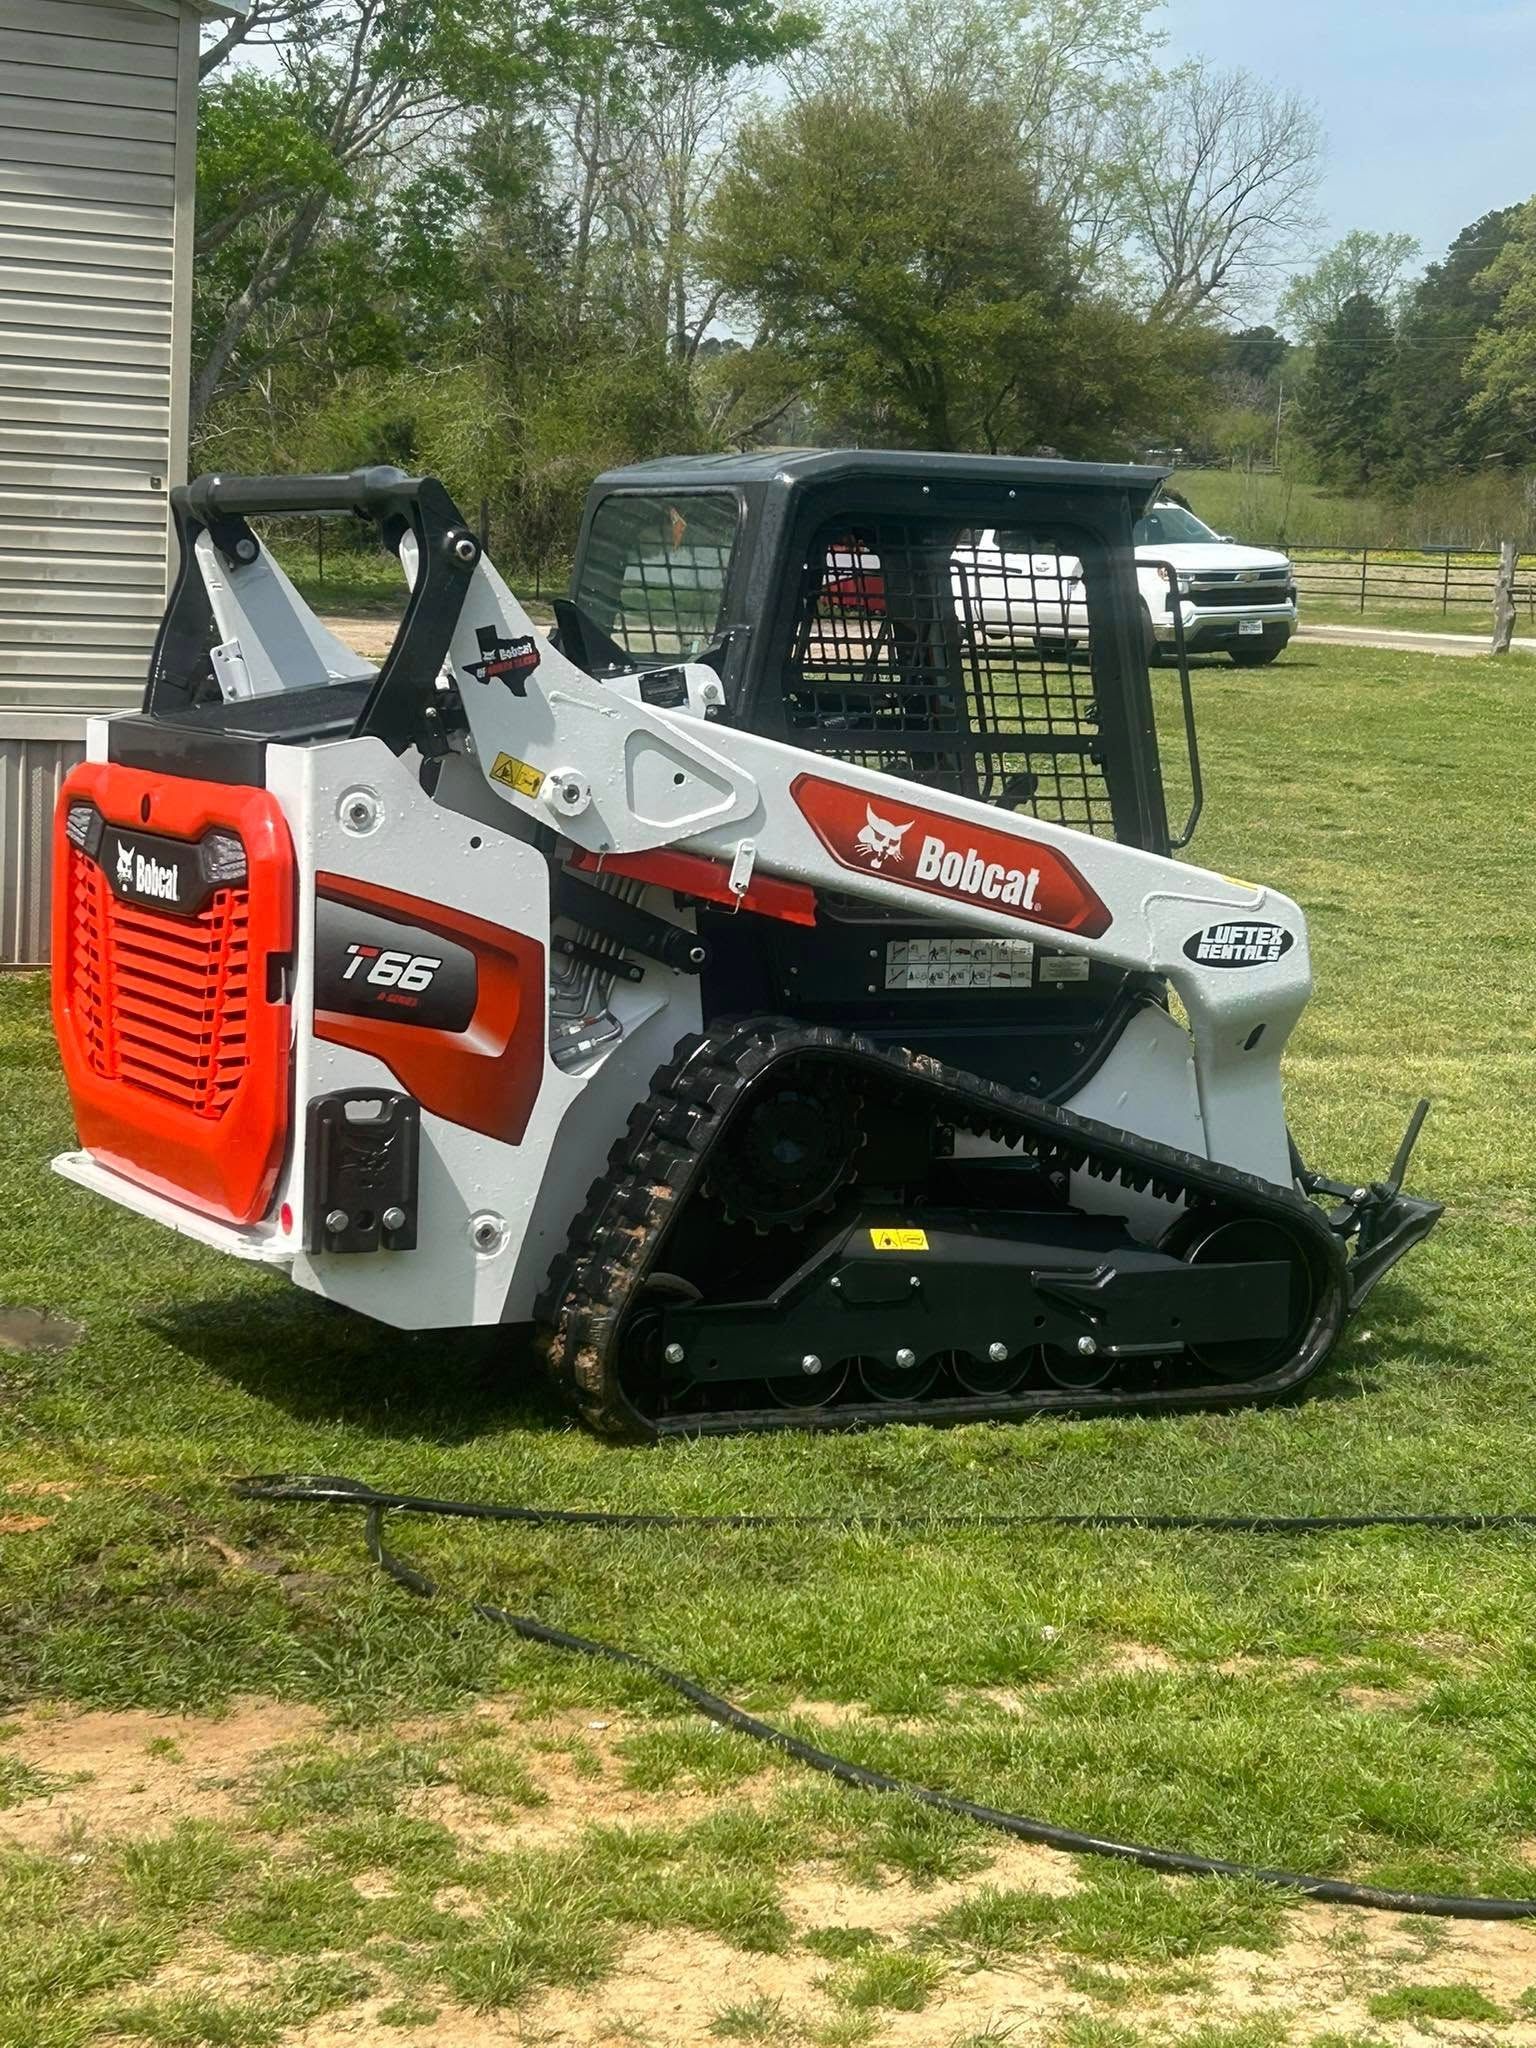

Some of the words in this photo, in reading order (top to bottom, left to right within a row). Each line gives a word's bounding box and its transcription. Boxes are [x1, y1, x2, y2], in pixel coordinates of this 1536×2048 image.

[499, 642, 533, 661] Bobcat
[136, 854, 180, 902] Bobcat
[915, 834, 1040, 912] Bobcat
[1196, 943, 1281, 961] RENTALS
[1200, 925, 1285, 946] LUFTEX
[342, 944, 442, 992] T66
